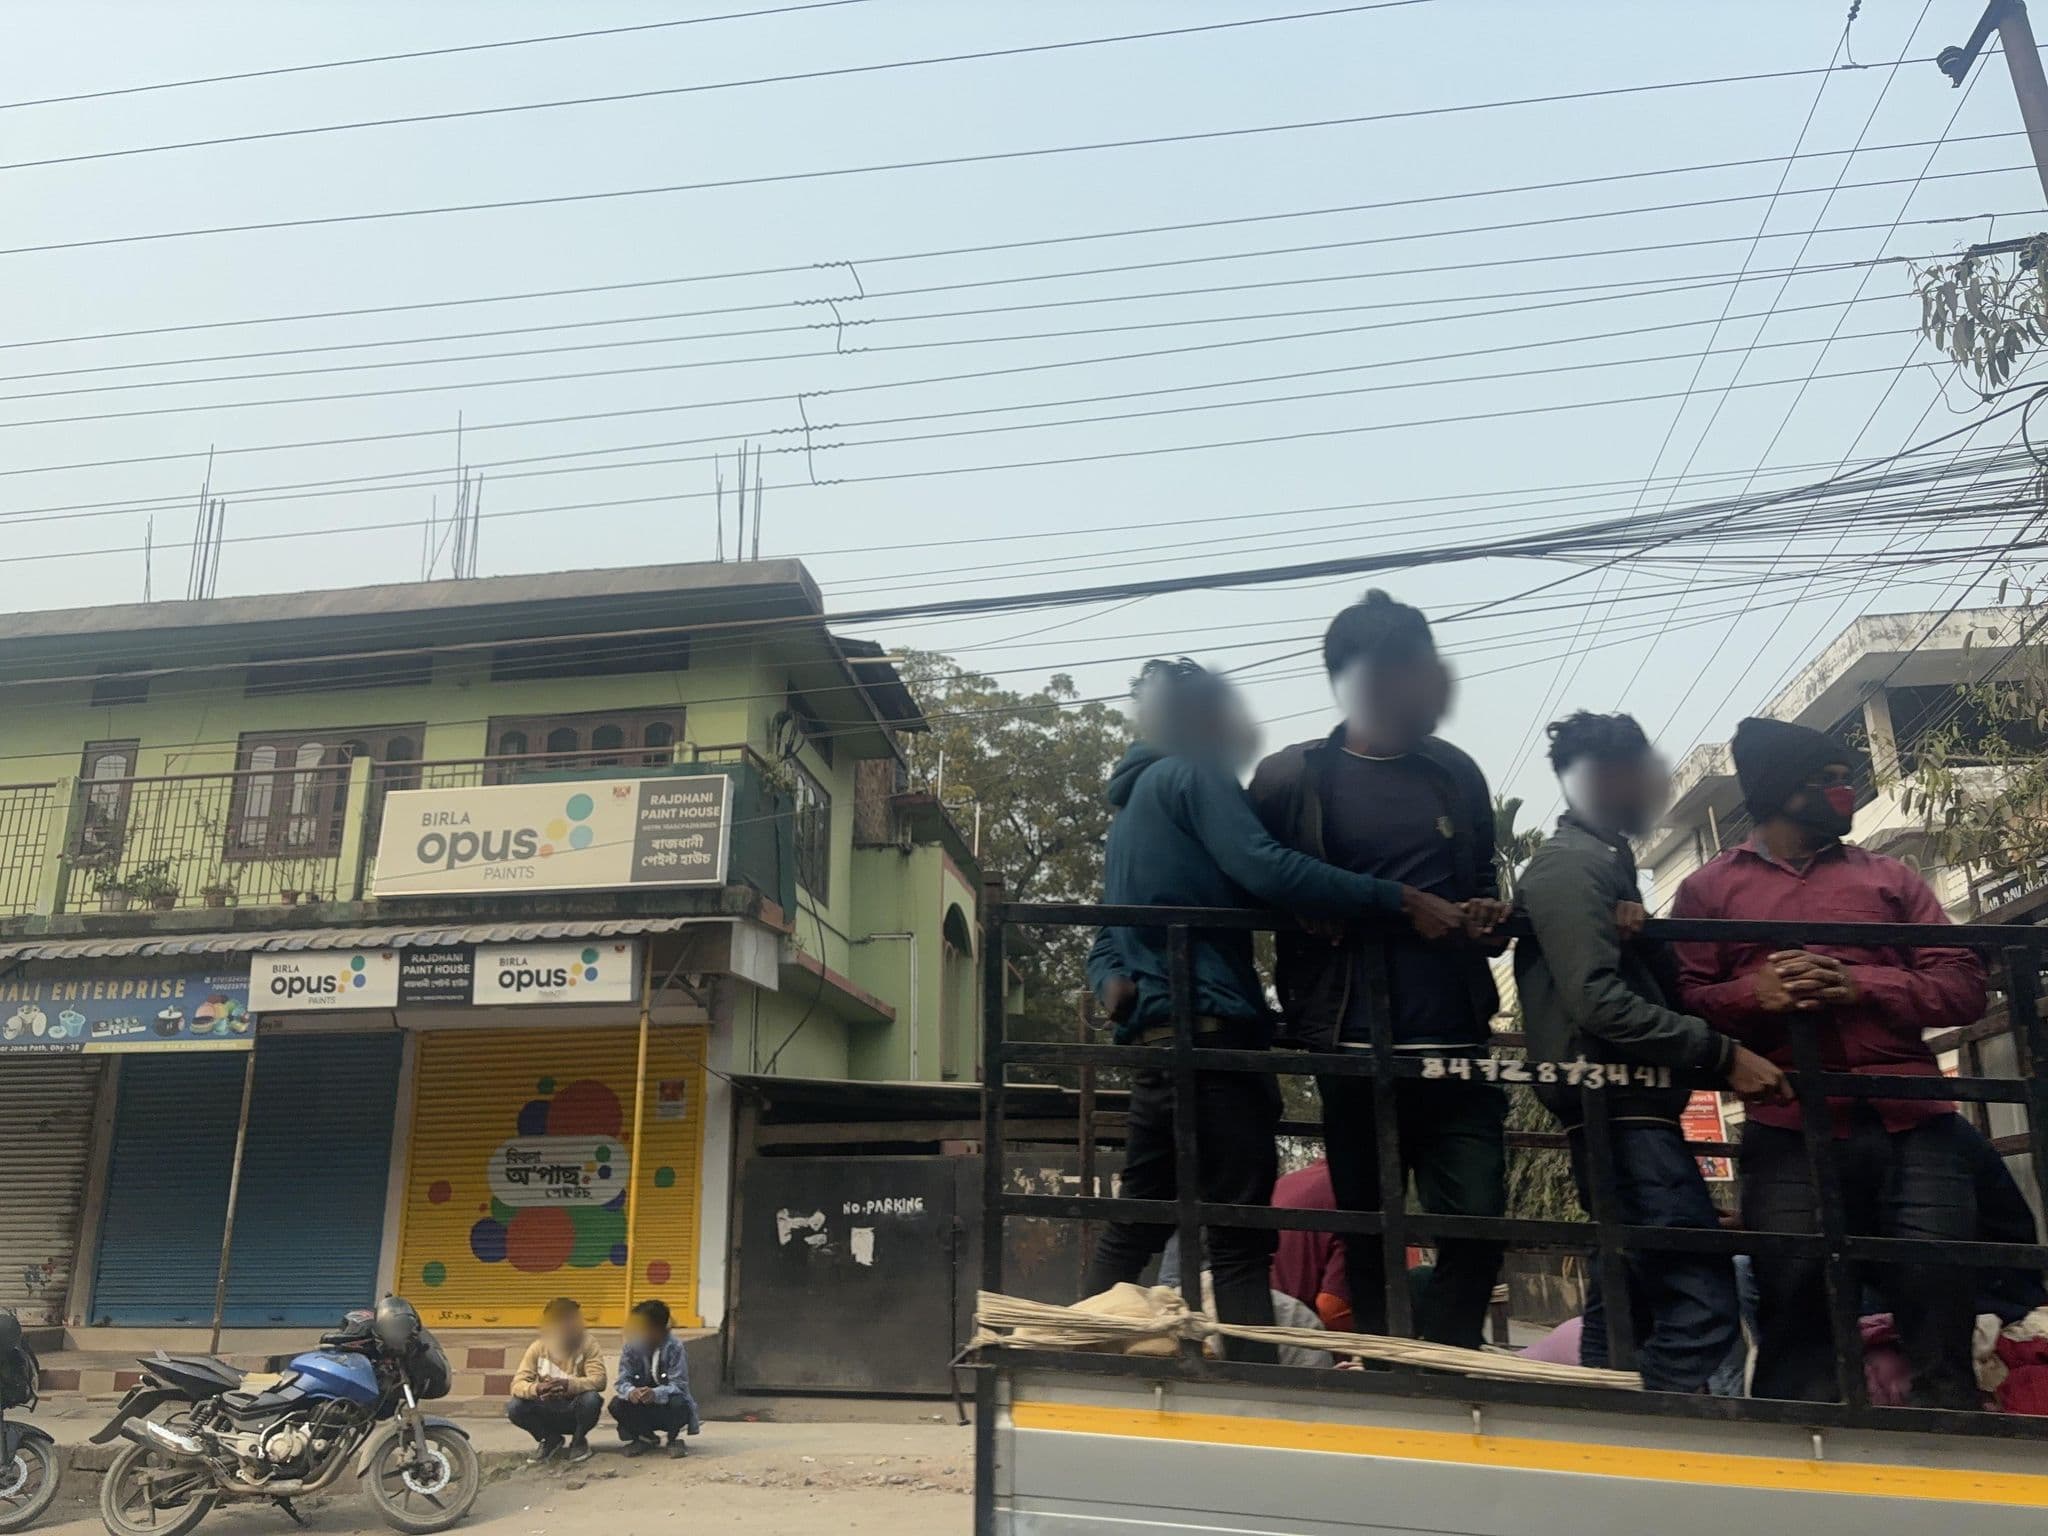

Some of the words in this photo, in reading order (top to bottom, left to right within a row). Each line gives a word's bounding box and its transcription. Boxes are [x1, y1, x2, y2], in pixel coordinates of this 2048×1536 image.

[650, 792, 713, 805] RAJDHANI
[421, 811, 471, 827] BIRLA
[640, 808, 678, 820] PAINT
[680, 805, 720, 818] HOUSE
[417, 828, 539, 870] opus
[484, 865, 535, 880] PAINTS
[411, 953, 463, 963] RAJDHANI
[499, 956, 528, 967] BIRLA
[272, 964, 300, 974] BIRLA
[403, 965, 432, 975] PAINT
[434, 963, 470, 974] HOUSE
[271, 974, 337, 998] opus
[498, 968, 567, 992] opus
[51, 978, 187, 1001] ENTERPRISE
